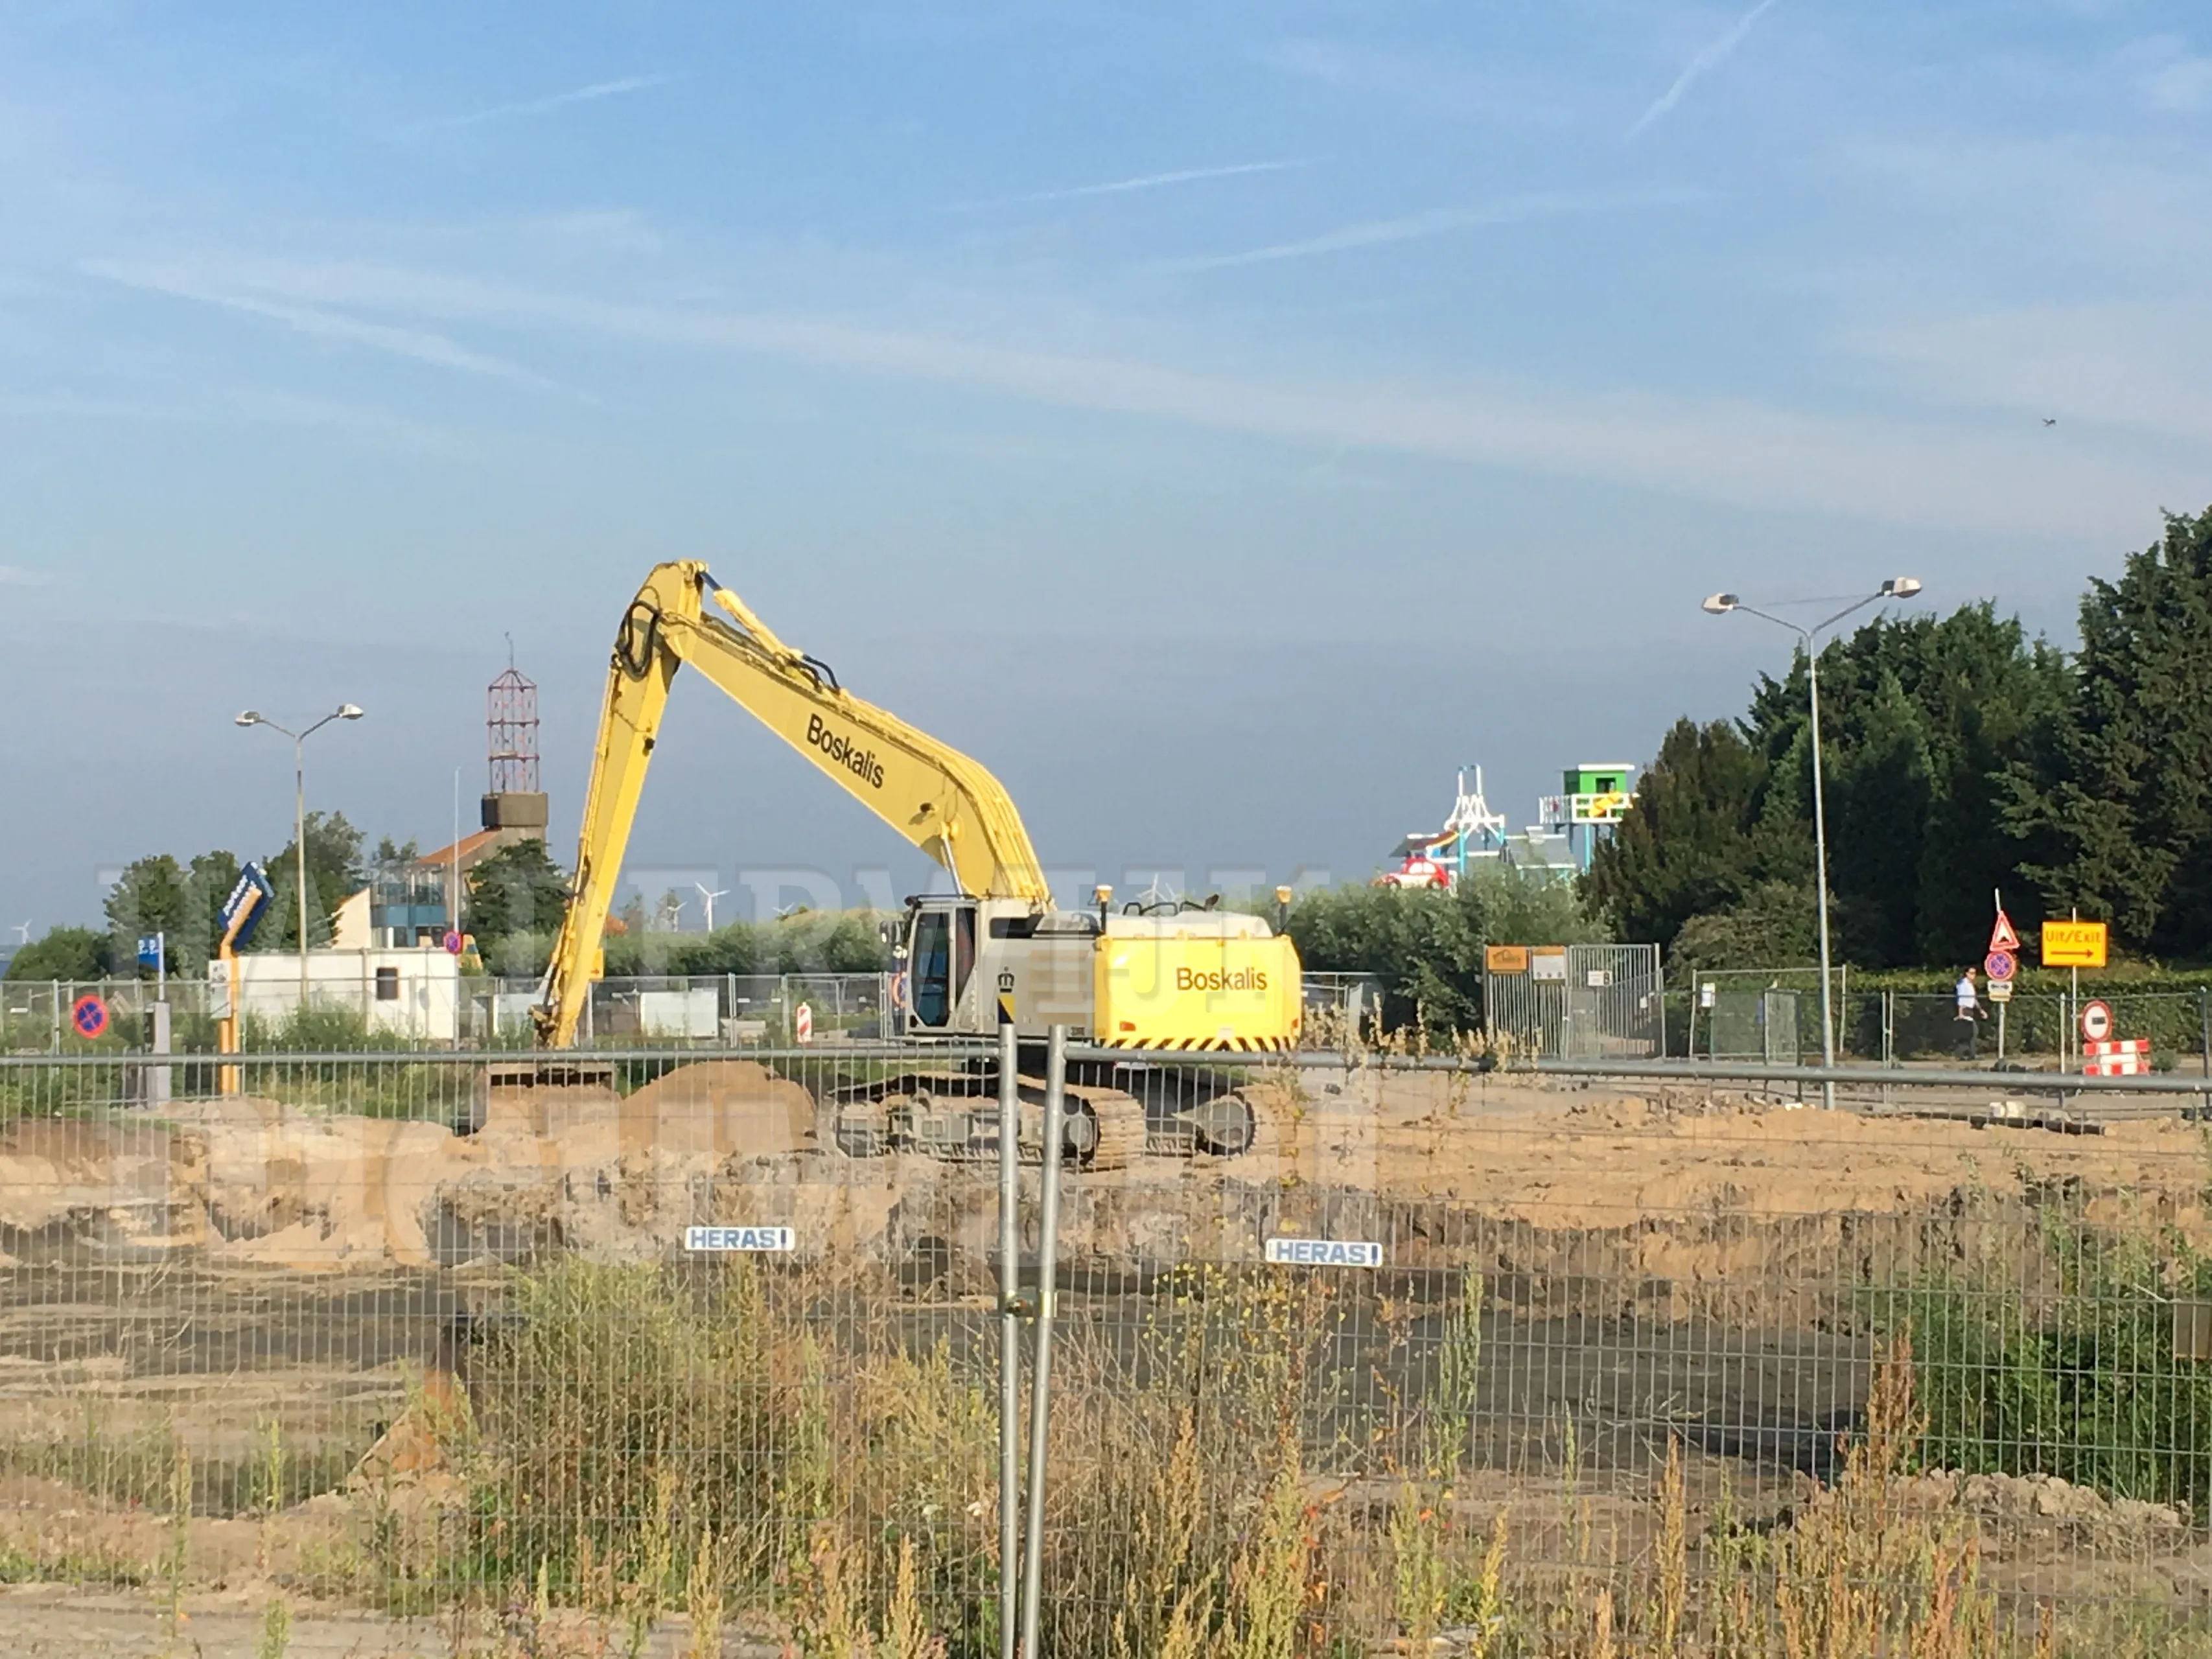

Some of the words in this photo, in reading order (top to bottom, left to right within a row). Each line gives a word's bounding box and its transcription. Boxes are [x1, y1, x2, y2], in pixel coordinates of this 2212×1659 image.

[806, 712, 885, 789] Boskalis
[2045, 929, 2102, 944] Uit/Exit
[1176, 966, 1268, 992] Boskalis
[690, 1229, 776, 1249] HERAS
[1276, 1241, 1366, 1265] HERAS
